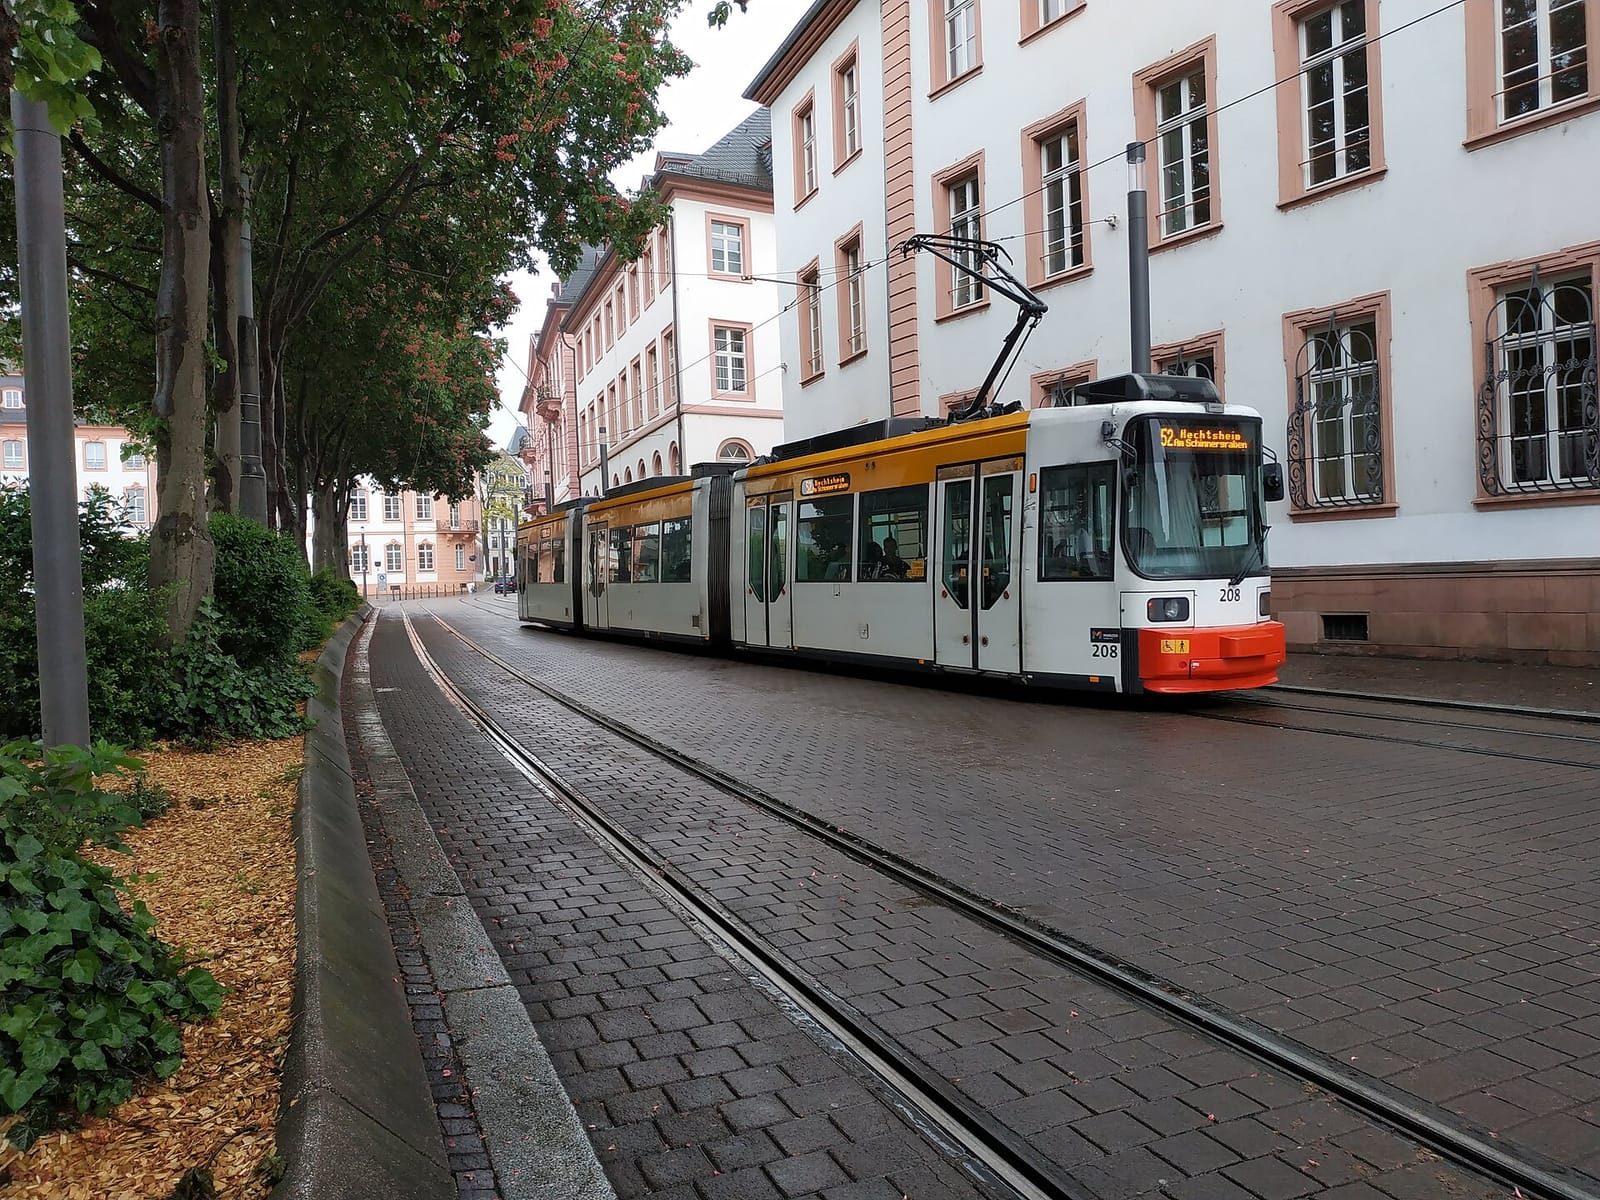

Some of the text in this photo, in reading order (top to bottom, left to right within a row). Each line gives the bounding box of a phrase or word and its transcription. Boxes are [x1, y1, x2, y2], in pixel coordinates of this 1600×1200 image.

[1160, 427, 1174, 447] 52
[1219, 588, 1241, 602] 208
[1092, 644, 1118, 658] 208
